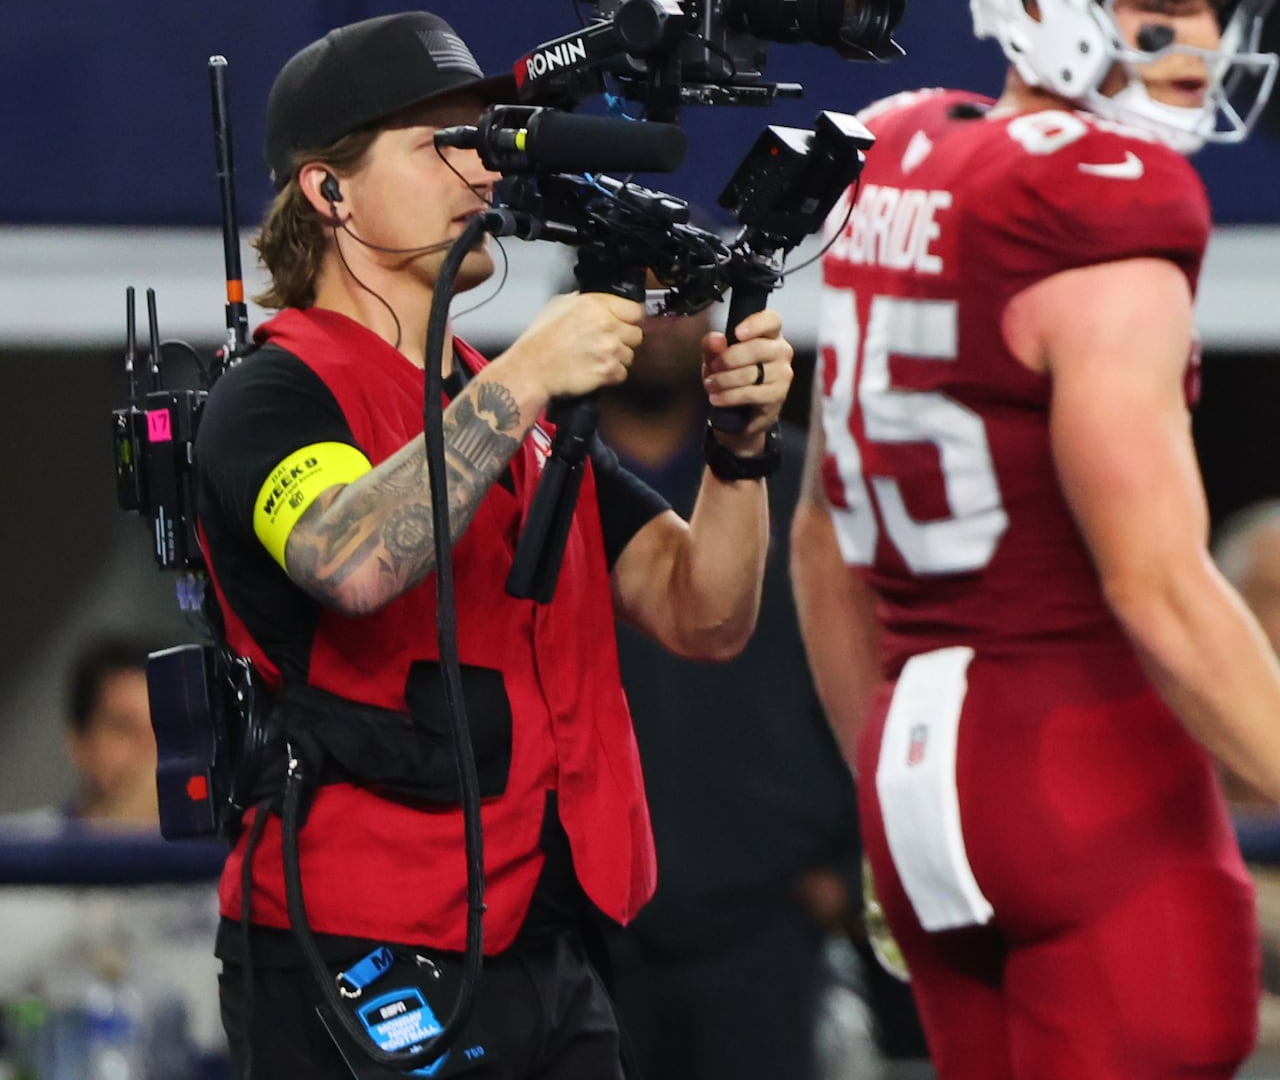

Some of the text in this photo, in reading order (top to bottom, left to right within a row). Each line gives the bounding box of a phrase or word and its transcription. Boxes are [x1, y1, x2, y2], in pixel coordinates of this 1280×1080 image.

[526, 38, 587, 80] RONIN
[152, 414, 167, 432] 17
[263, 465, 303, 514] WEEK
[379, 1000, 407, 1020] ESPN
